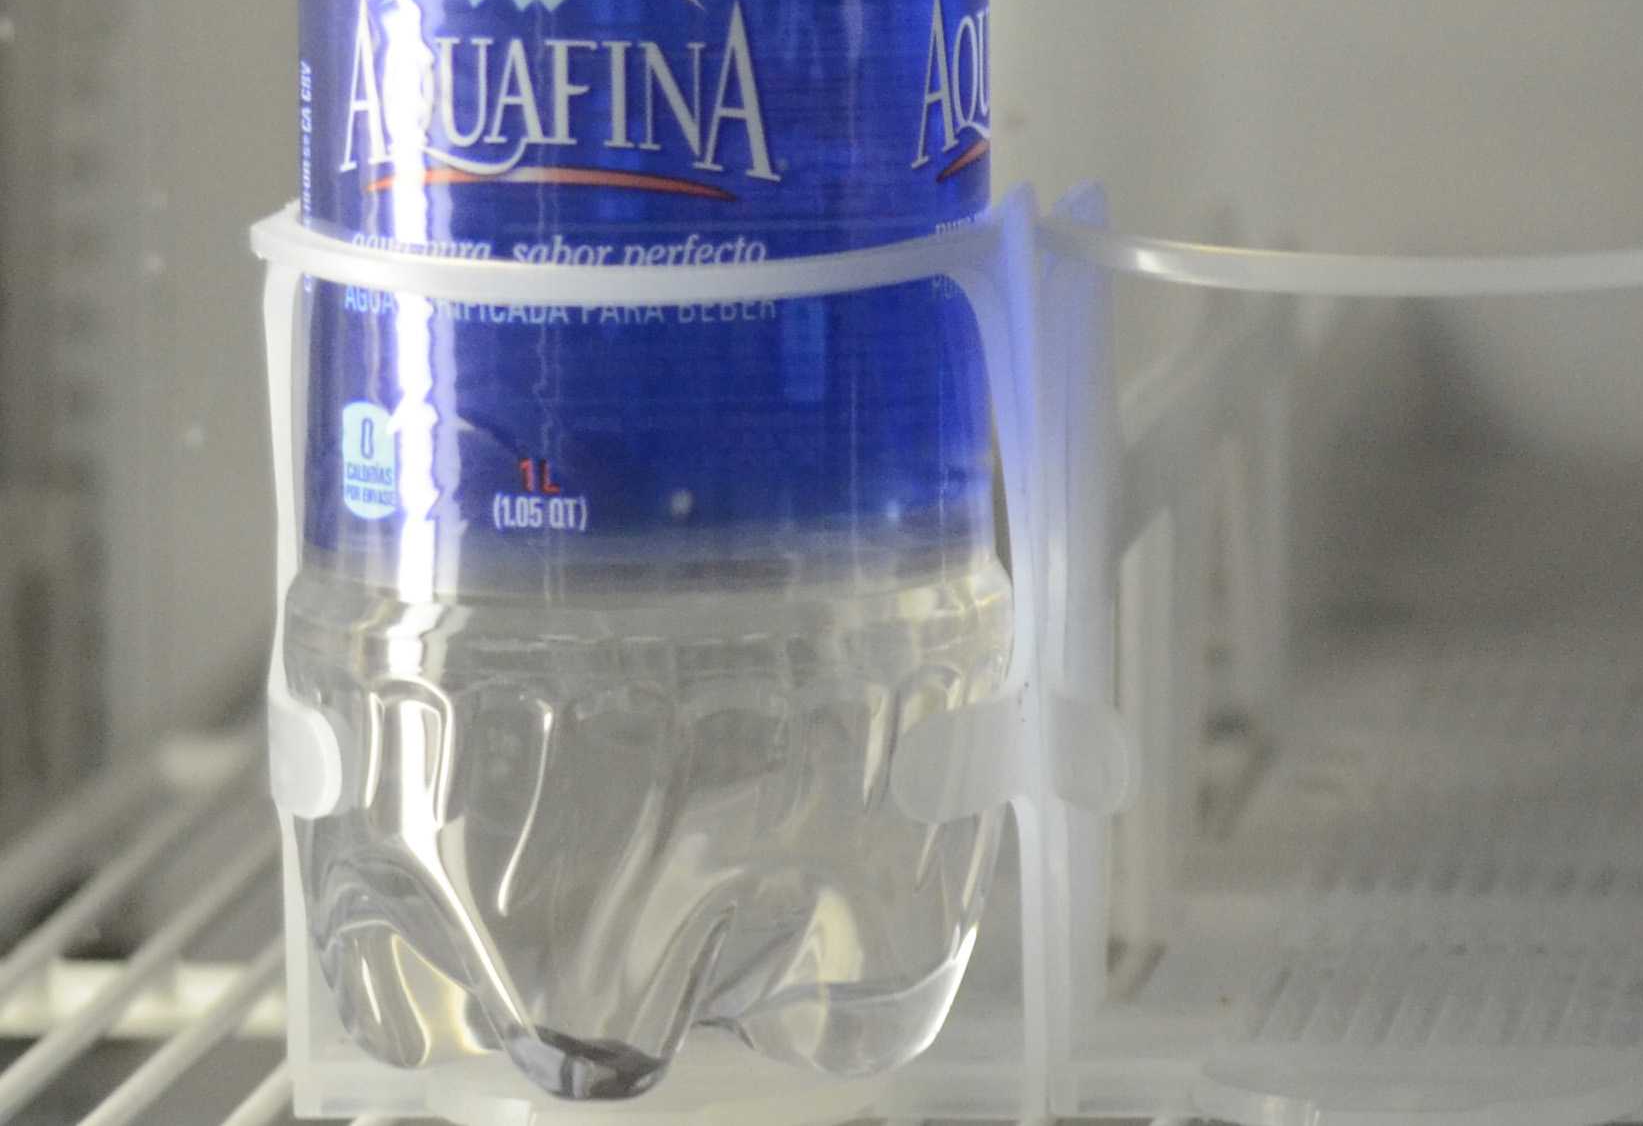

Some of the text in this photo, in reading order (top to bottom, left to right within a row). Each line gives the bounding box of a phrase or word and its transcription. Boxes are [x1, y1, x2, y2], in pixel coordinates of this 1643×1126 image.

[512, 234, 612, 265] sabor
[624, 233, 767, 265] perfecto
[517, 458, 562, 495] 1 L
[492, 492, 589, 531] (1.05 QT)
